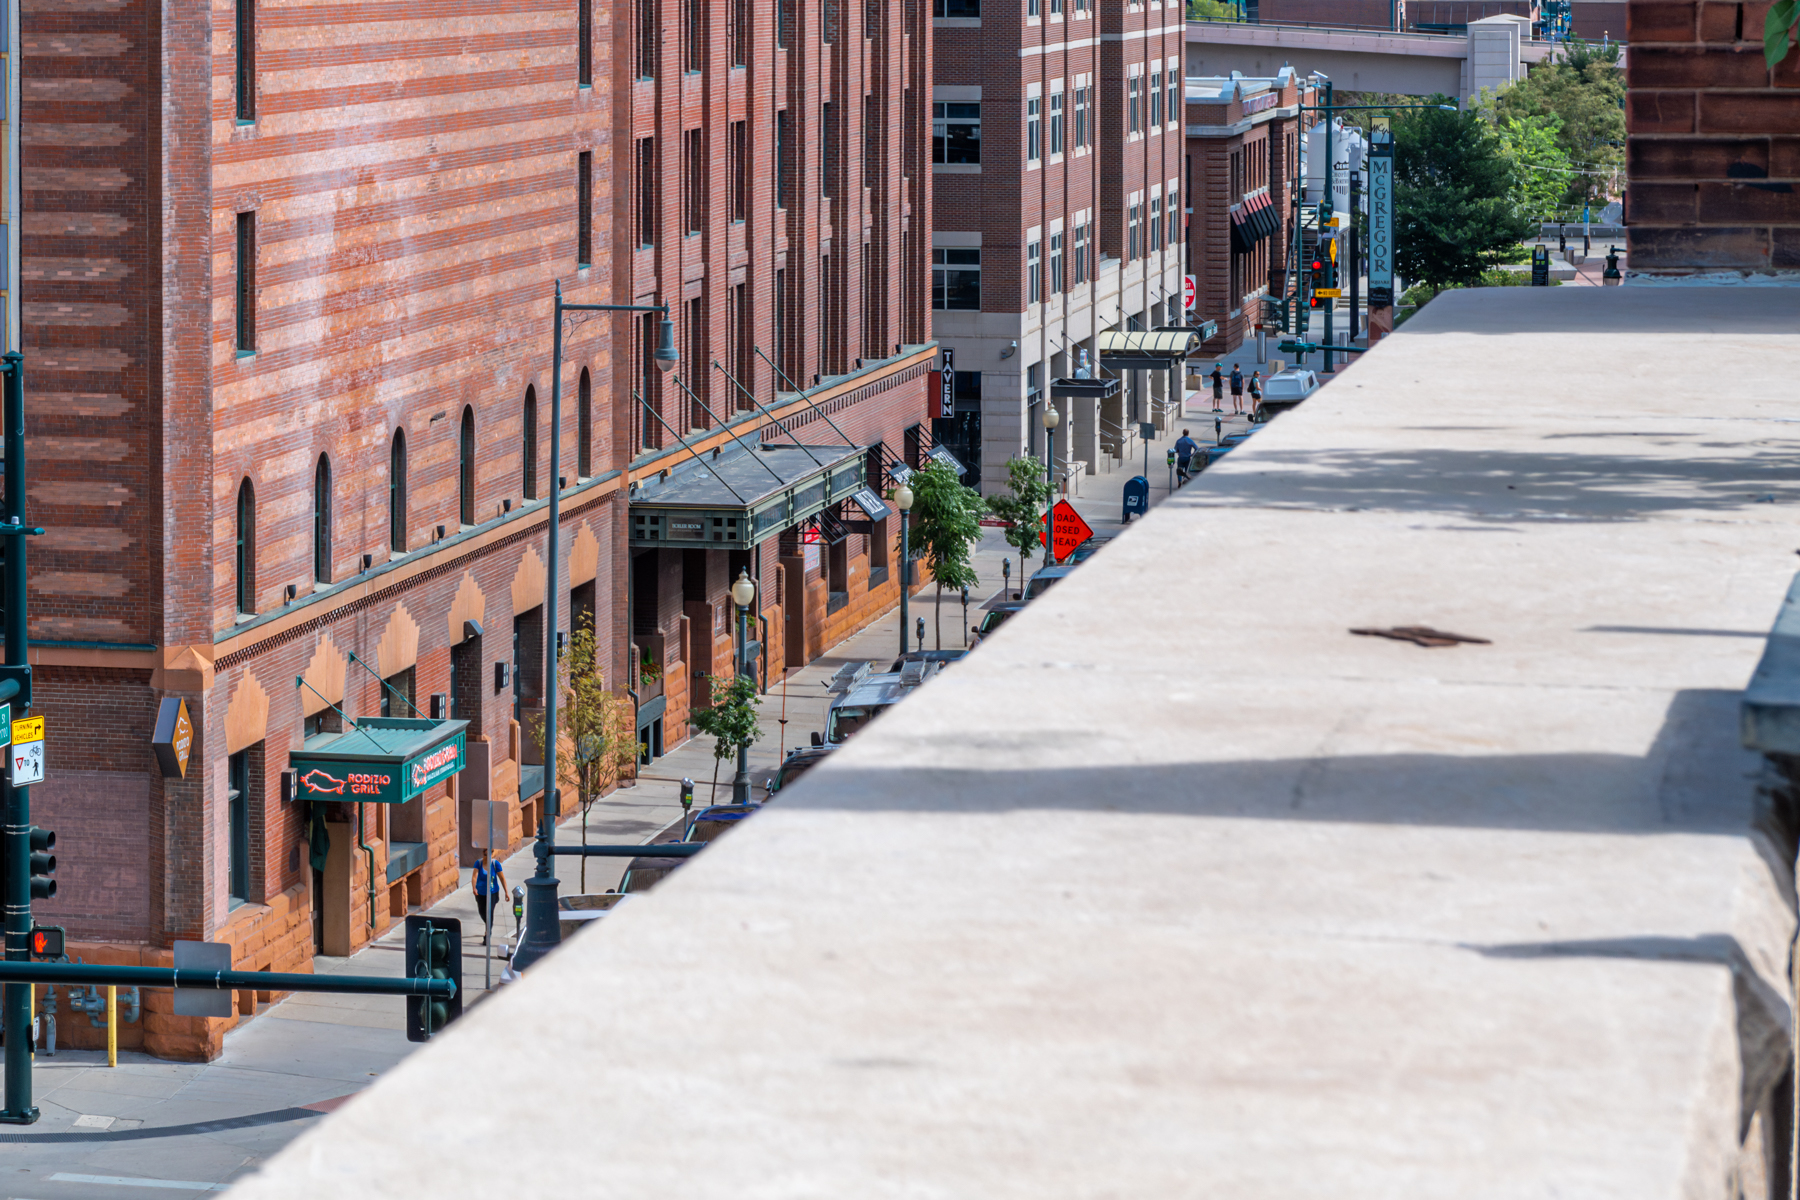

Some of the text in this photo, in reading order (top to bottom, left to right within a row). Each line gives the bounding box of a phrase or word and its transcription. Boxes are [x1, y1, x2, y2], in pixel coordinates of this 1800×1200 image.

[943, 351, 953, 416] TAVERN
[1053, 538, 1077, 547] HEAD
[14, 722, 33, 732] TURNING
[14, 731, 33, 741] VEHICLES
[24, 758, 30, 767] TO
[347, 773, 391, 786] RODIZIO
[350, 784, 381, 794] GRILL
